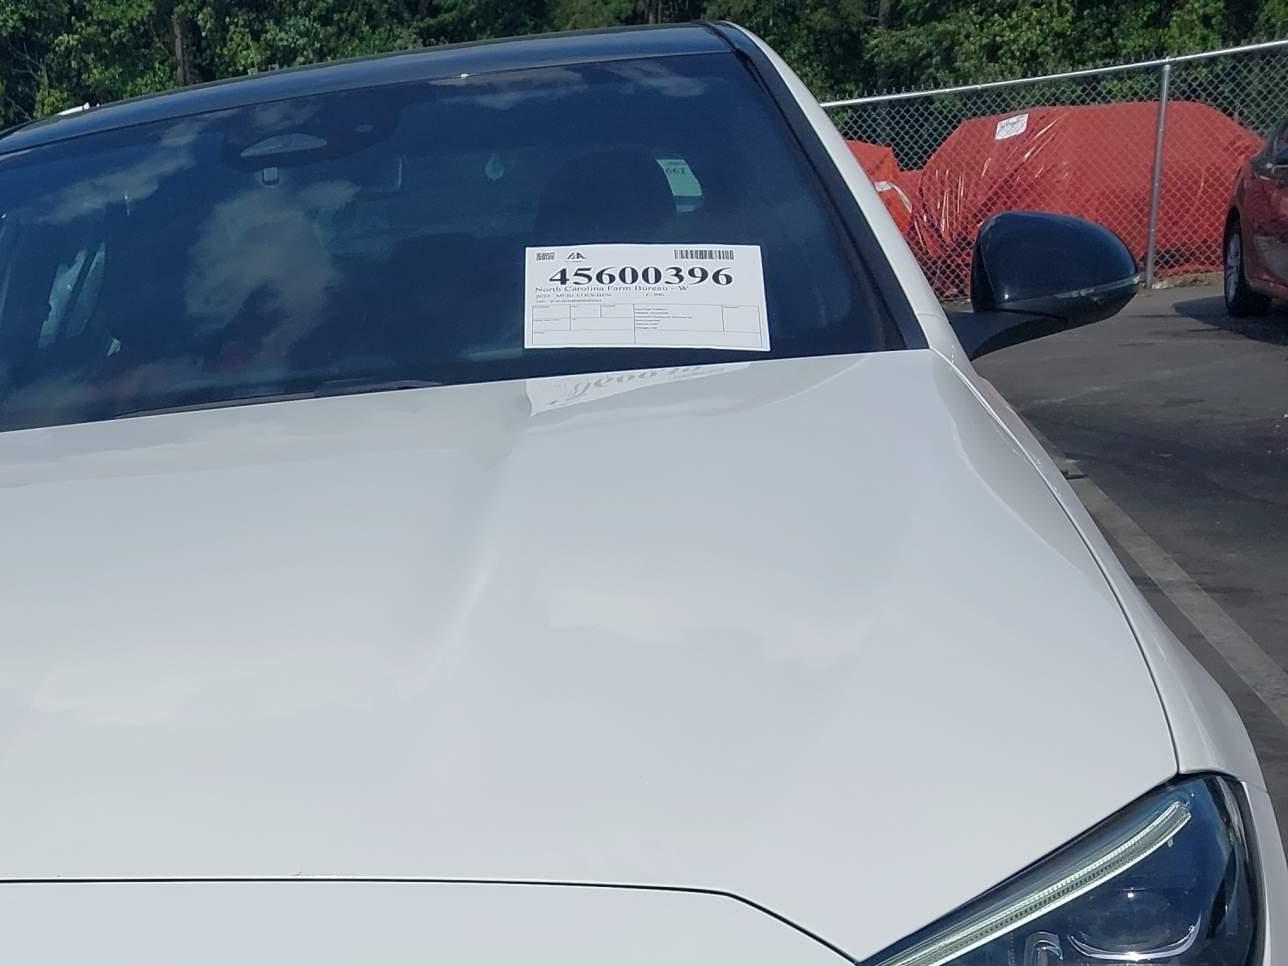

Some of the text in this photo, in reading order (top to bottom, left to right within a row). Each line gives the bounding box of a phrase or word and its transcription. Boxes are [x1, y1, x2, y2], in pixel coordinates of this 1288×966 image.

[549, 266, 733, 286] 45600396
[535, 285, 561, 293] North
[564, 284, 604, 292] Carolina
[607, 284, 632, 292] Farm
[634, 284, 668, 292] Bureau
